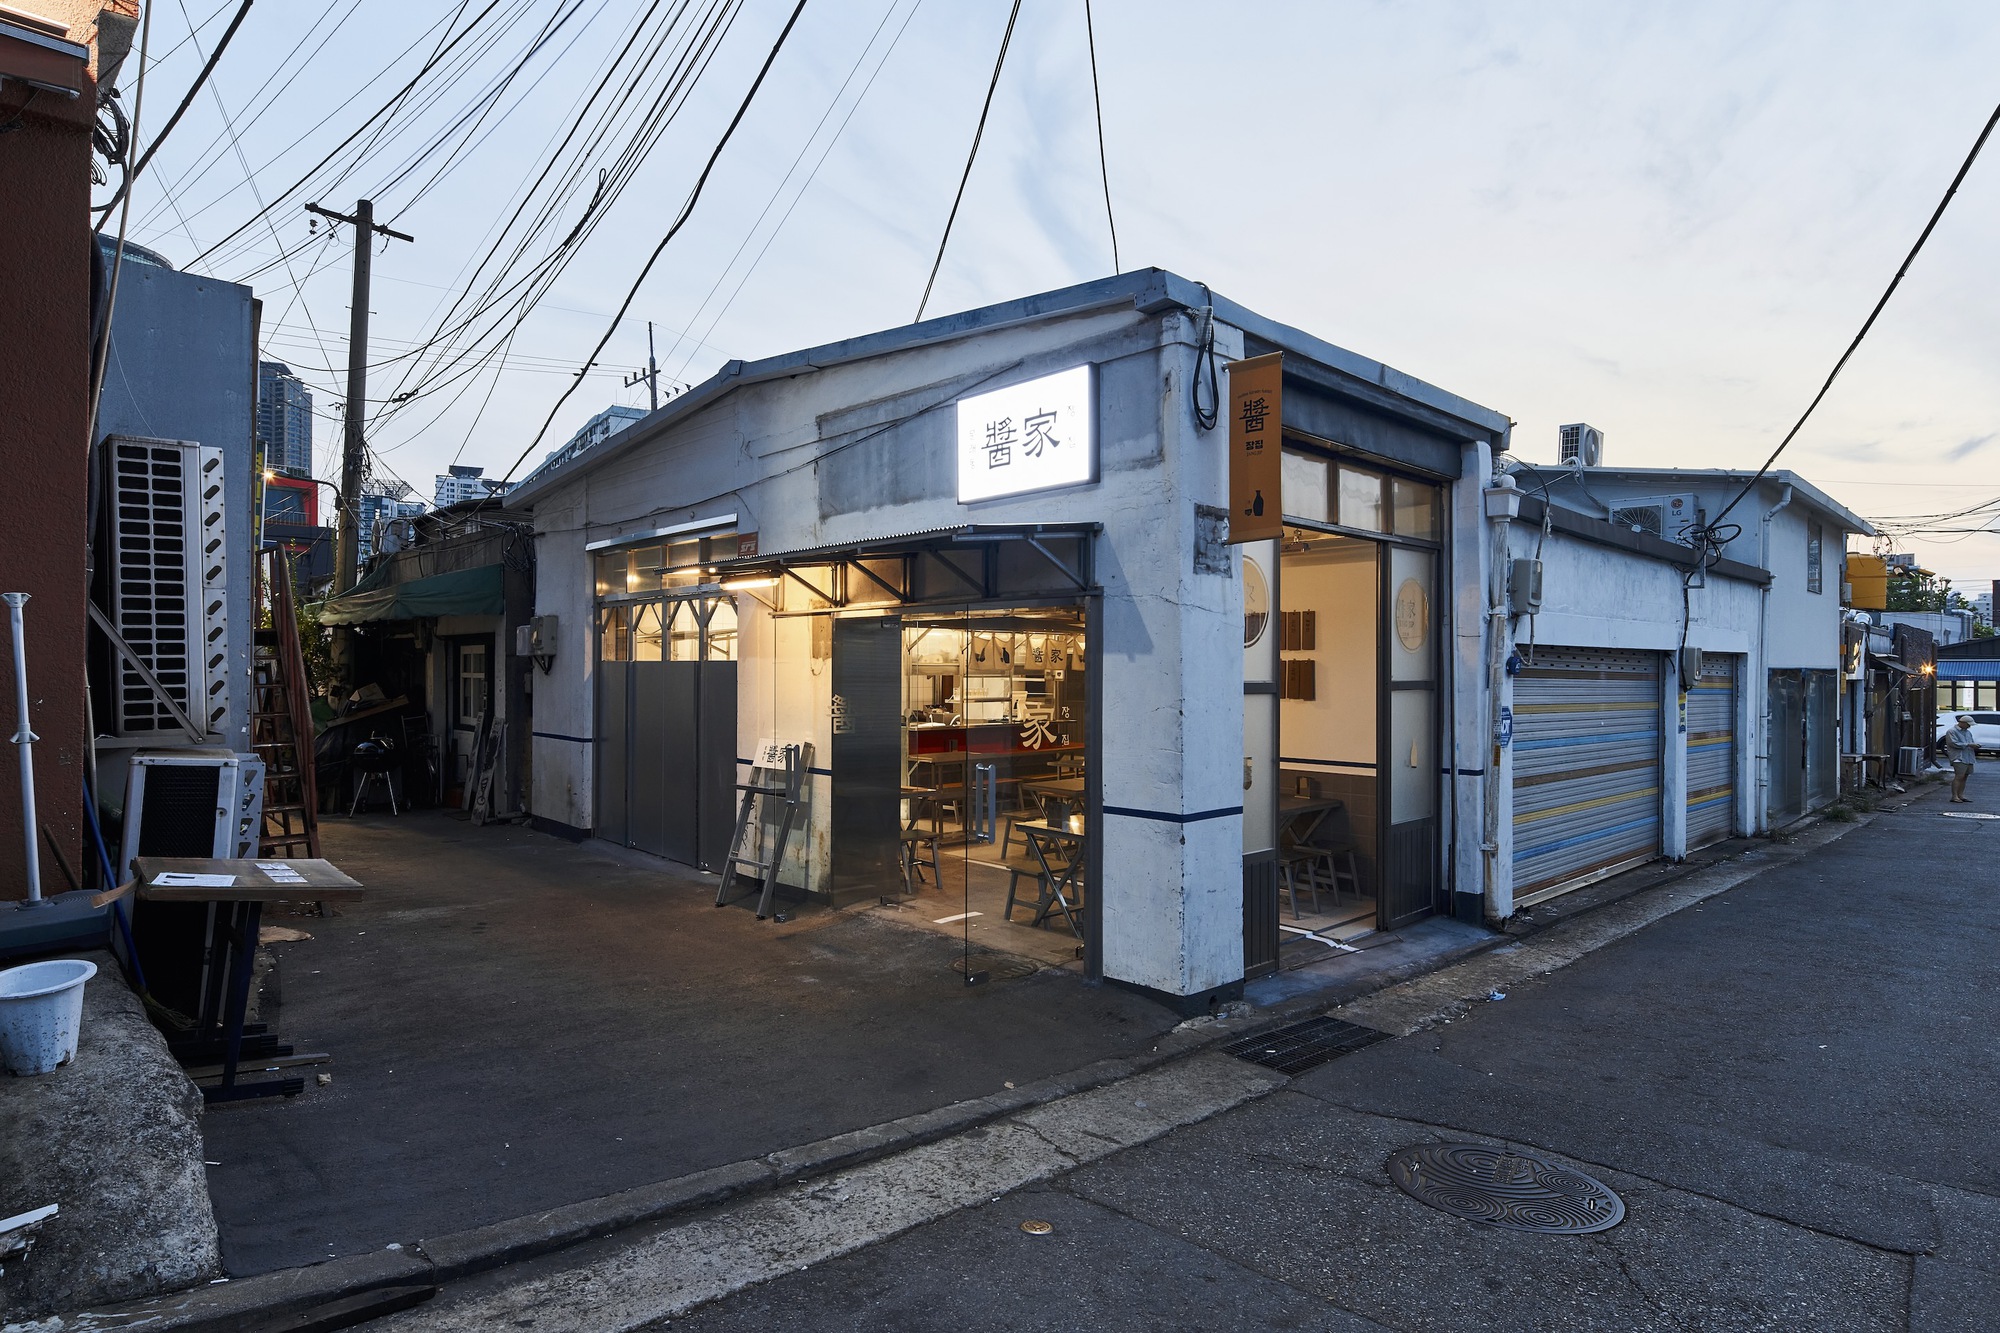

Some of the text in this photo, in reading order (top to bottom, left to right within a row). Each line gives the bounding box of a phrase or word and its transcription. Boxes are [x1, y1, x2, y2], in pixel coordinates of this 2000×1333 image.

[1239, 397, 1271, 434] 醬
[981, 407, 1061, 470] 醬家
[1245, 439, 1264, 451] 장집
[1019, 703, 1058, 751] 家
